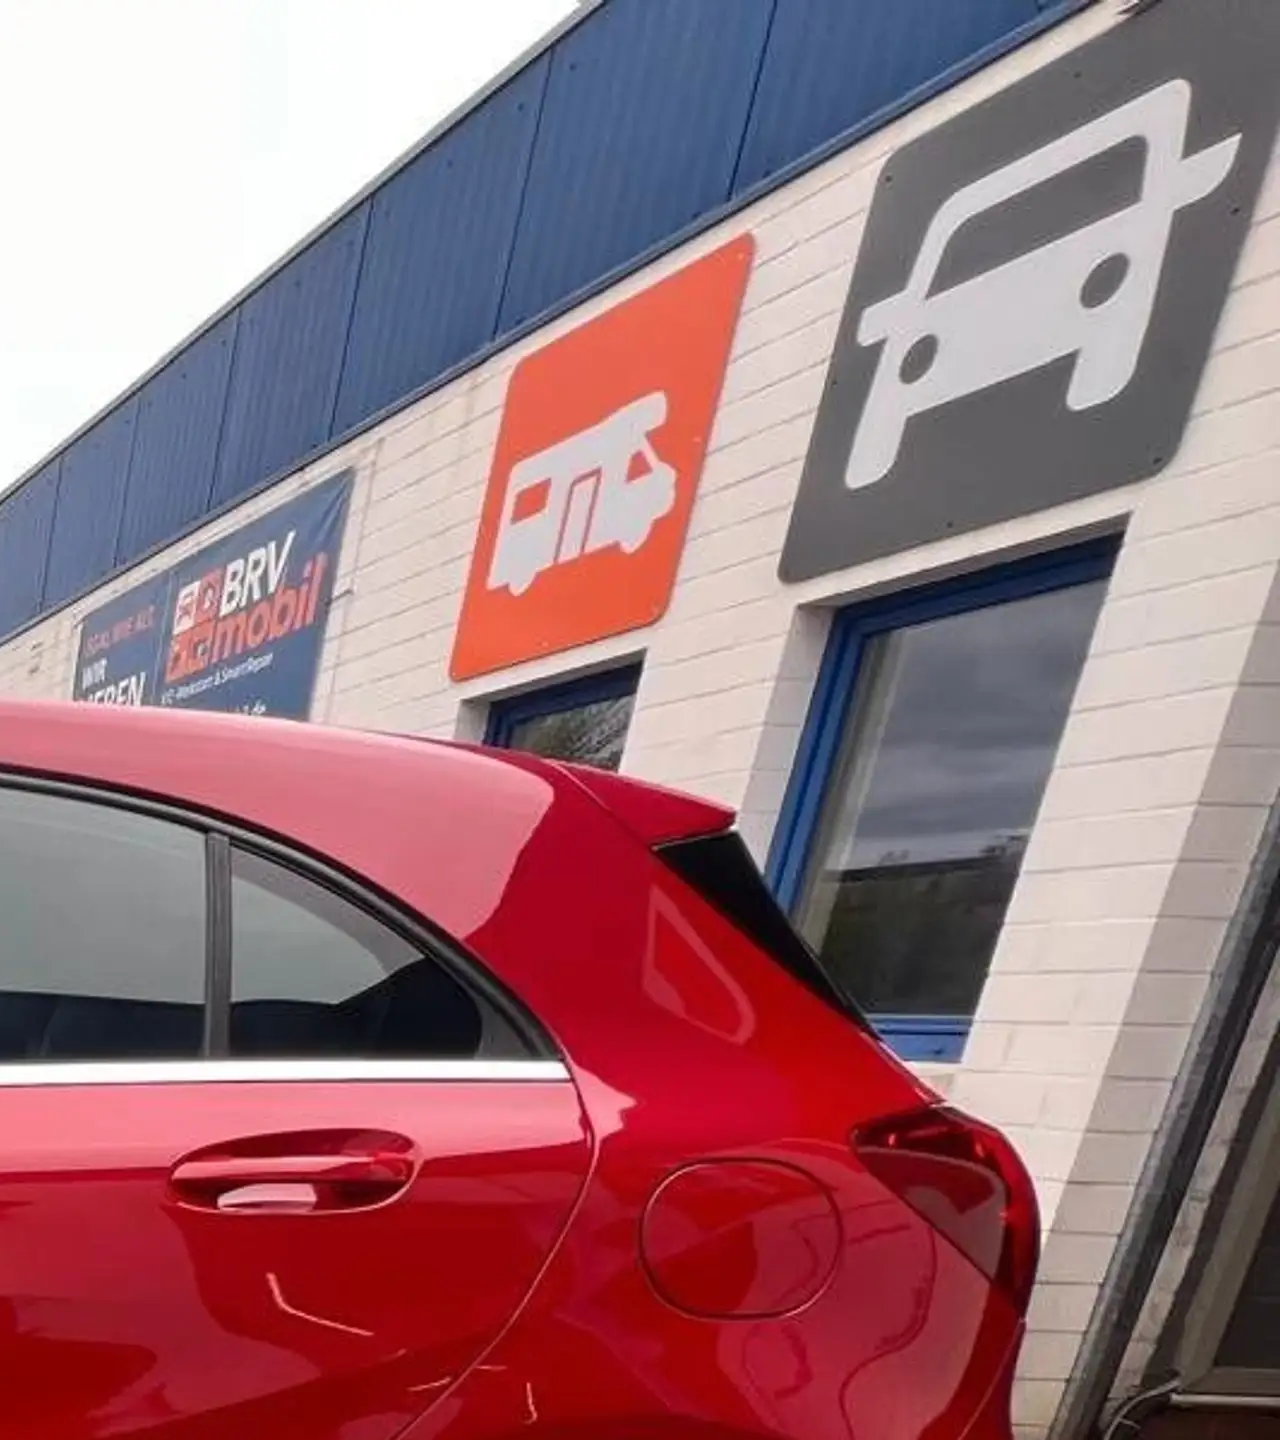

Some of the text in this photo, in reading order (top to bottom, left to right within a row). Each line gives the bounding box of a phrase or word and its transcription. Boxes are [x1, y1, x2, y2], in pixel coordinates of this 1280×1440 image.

[211, 551, 329, 664] mobil
[219, 529, 297, 619] BRV
[82, 657, 108, 691] WIR
